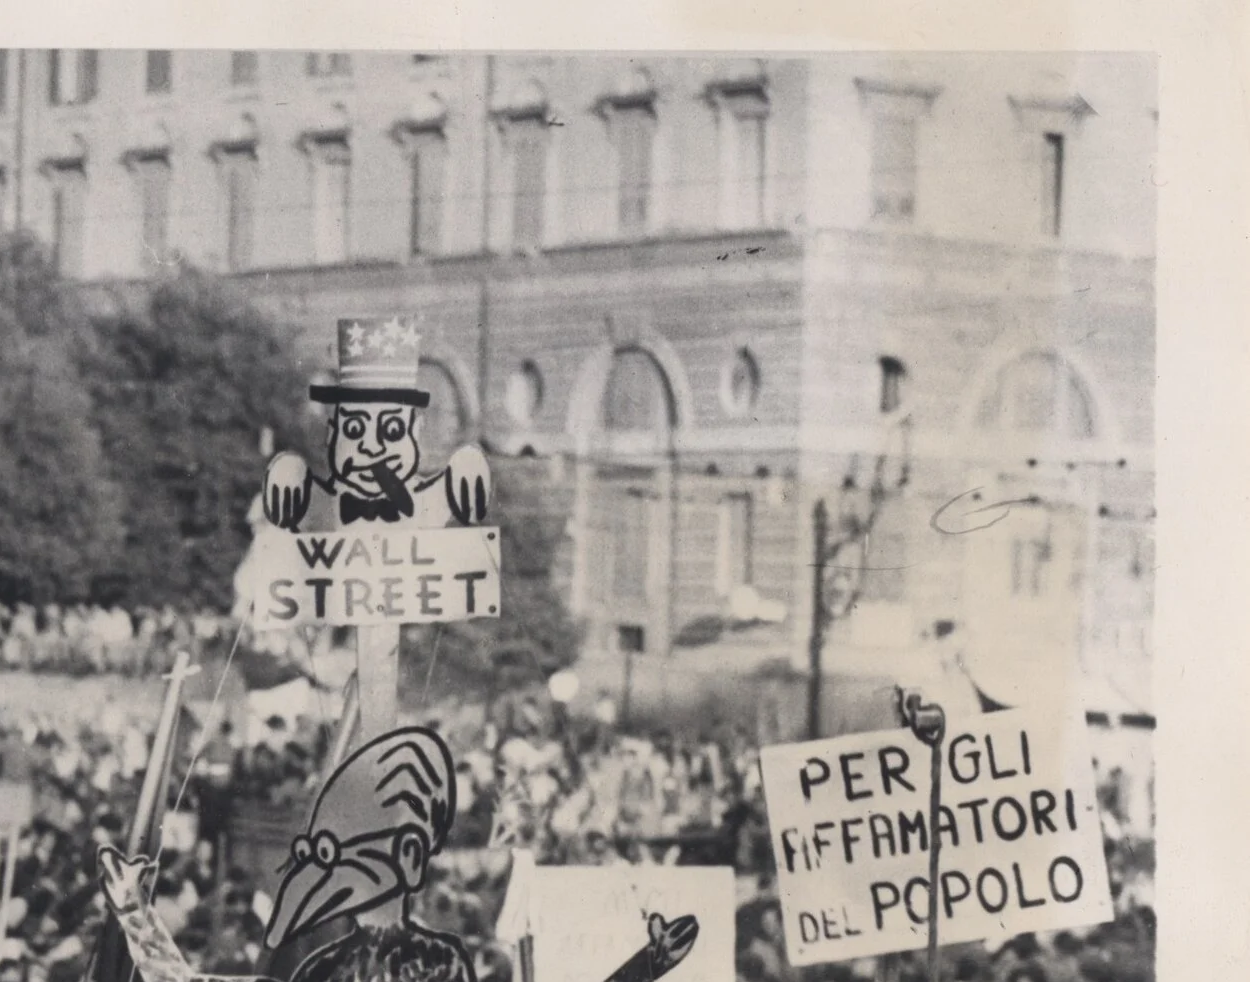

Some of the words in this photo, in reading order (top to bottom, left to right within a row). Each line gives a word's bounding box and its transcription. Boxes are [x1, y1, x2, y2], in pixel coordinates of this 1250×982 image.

[297, 535, 436, 570] WALL
[268, 570, 487, 620] STREET
[799, 746, 916, 804] PER
[948, 730, 1032, 785] GLI
[780, 788, 1078, 873] AFFAMATORI
[799, 907, 864, 944] DEL
[870, 856, 1085, 930] POPOLO
